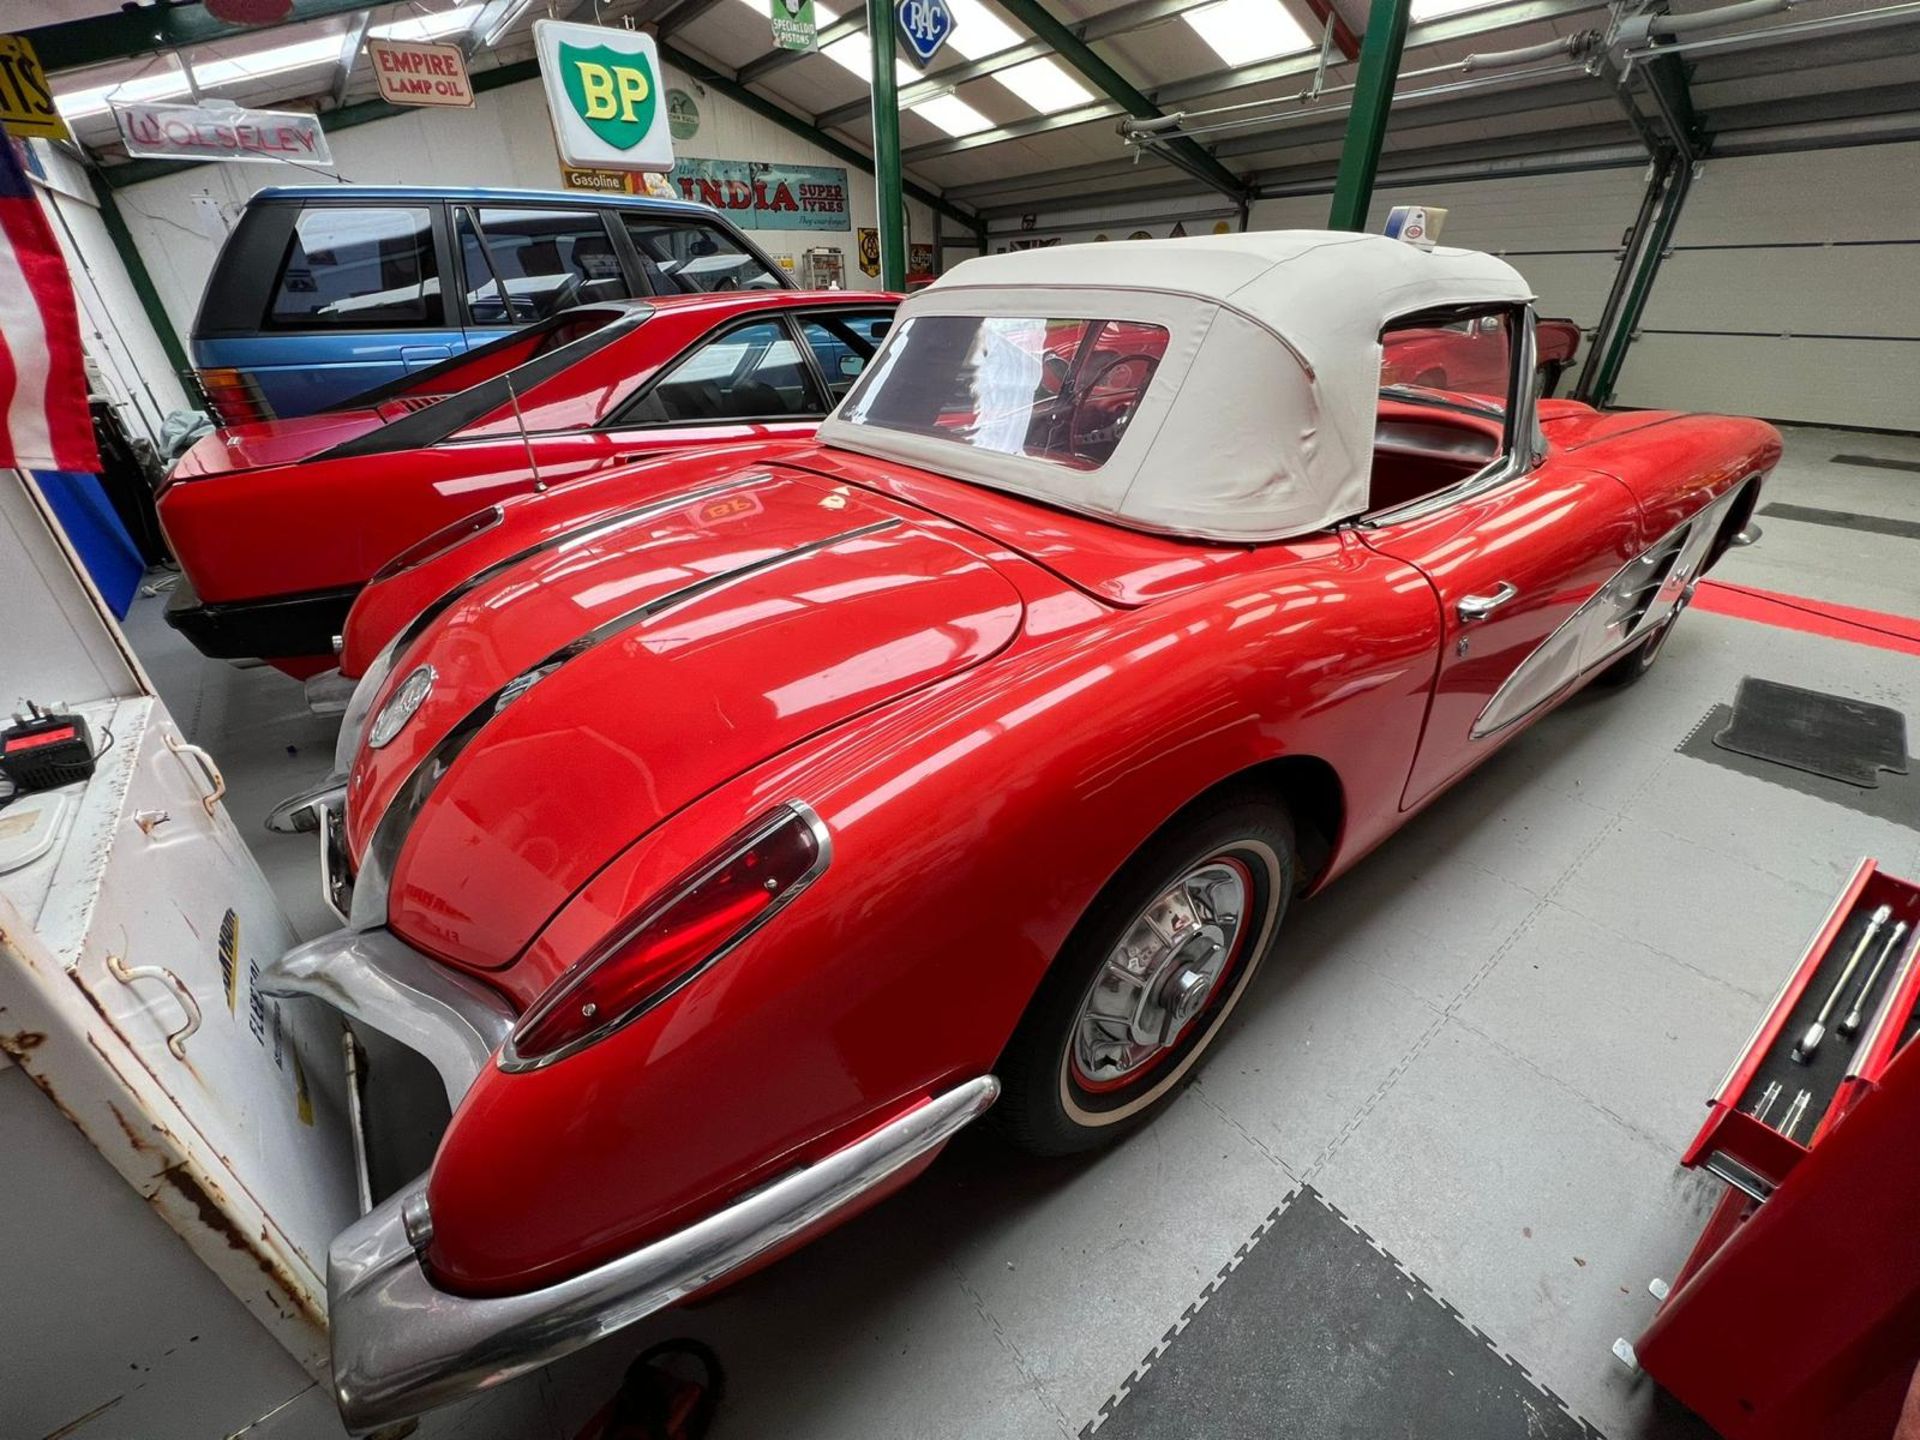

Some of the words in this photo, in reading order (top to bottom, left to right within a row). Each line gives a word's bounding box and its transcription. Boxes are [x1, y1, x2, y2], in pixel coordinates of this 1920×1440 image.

[910, 0, 941, 40] RAC
[780, 32, 810, 45] PISTONS
[377, 50, 458, 77] EMPIRE
[386, 77, 432, 95] LAMP
[435, 81, 464, 97] OIL
[574, 61, 649, 122] BP
[126, 111, 314, 153] WOLSELEY
[571, 172, 620, 190] Gasoline
[799, 184, 843, 197] SUPER
[677, 177, 799, 213] INDIA
[802, 198, 844, 212] TYRES
